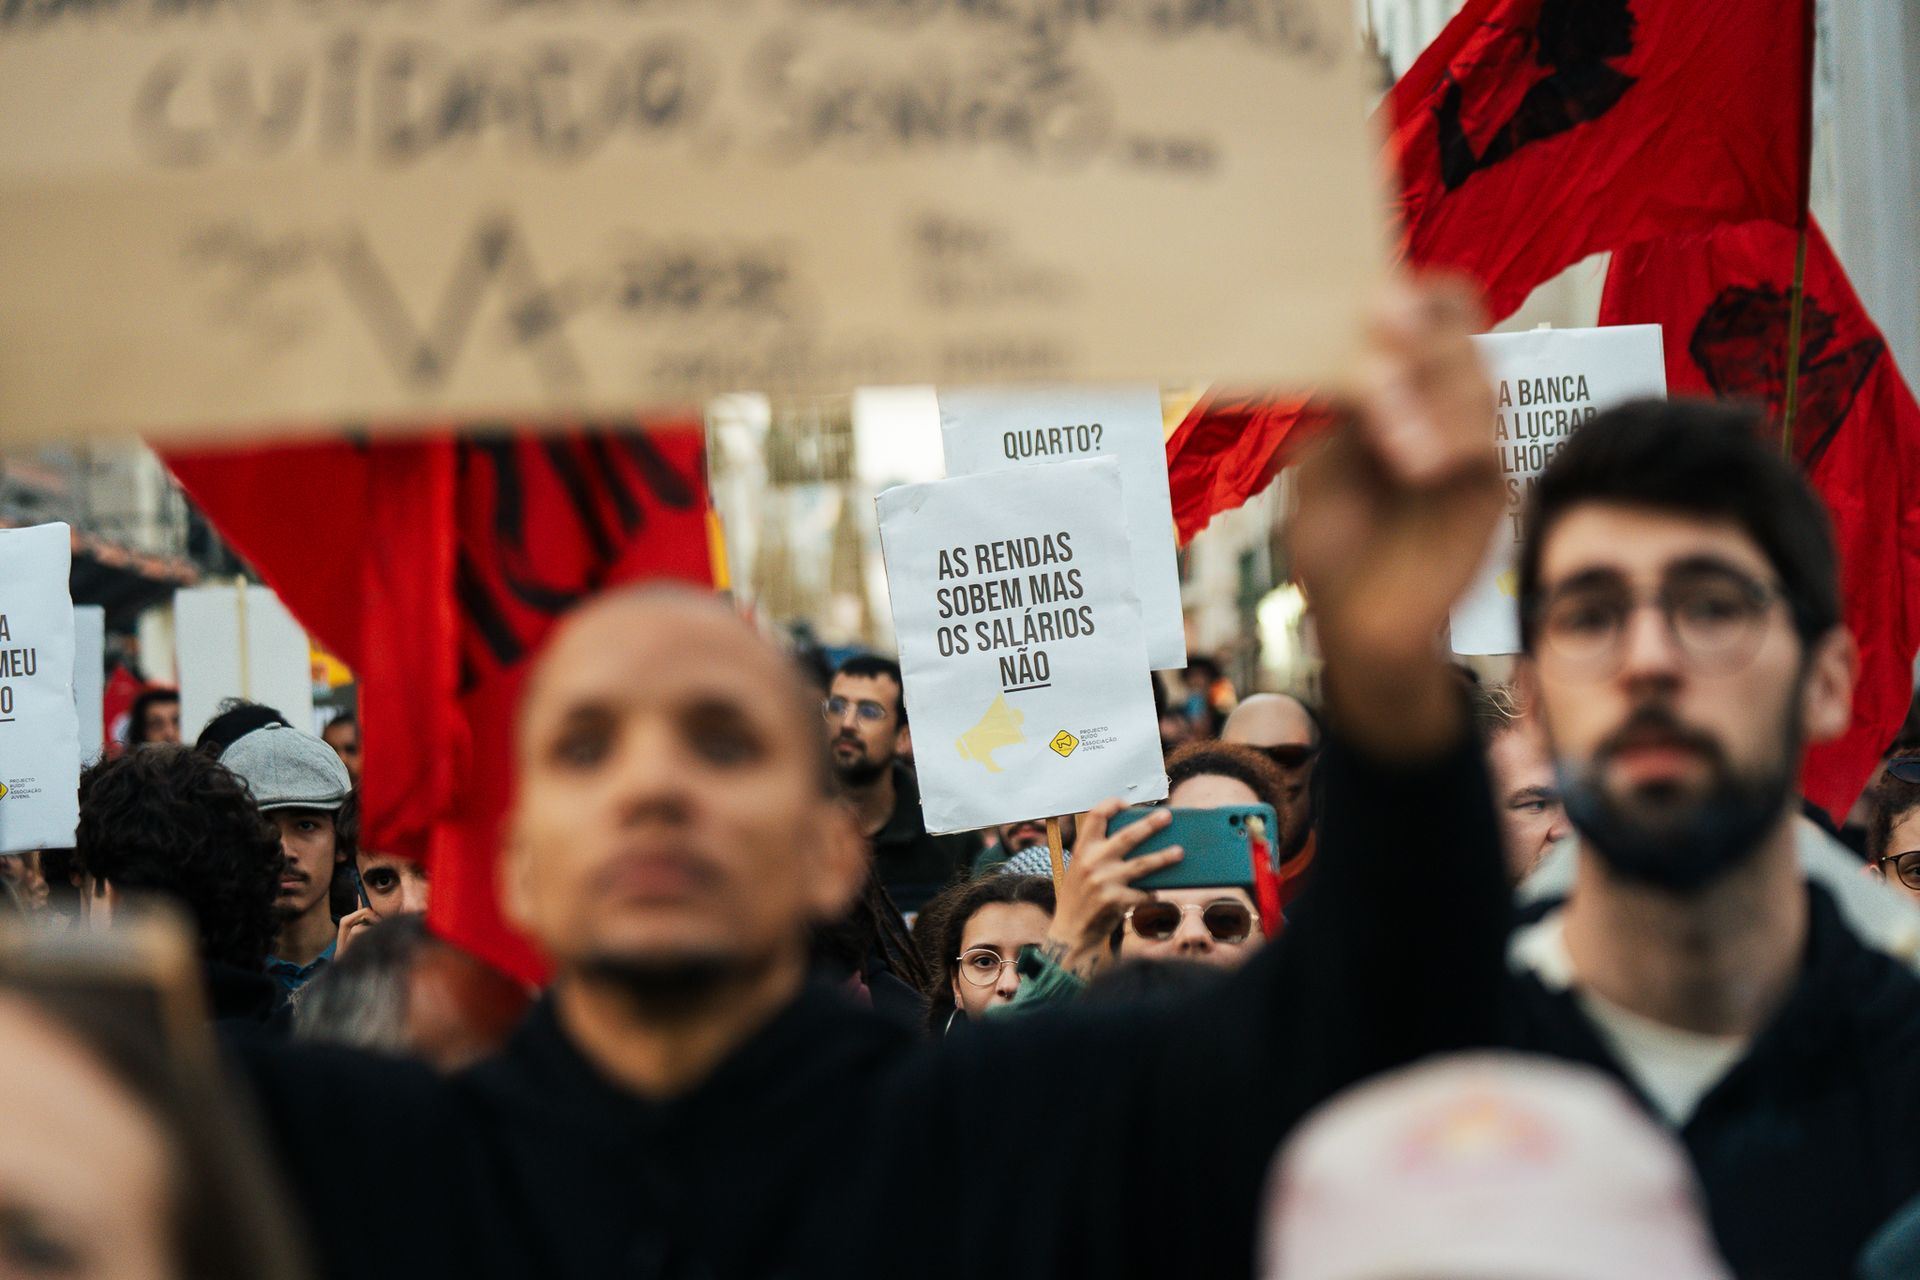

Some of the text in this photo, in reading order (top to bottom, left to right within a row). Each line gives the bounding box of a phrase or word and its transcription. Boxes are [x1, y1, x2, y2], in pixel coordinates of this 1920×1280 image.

[1518, 375, 1591, 407] BANCA
[1003, 423, 1104, 460] QUARTO?
[938, 531, 1073, 580] AS RENDAS
[936, 568, 1084, 619] SOBEM MAS
[937, 605, 1095, 657] OS SALÁRIOS
[999, 647, 1050, 687] NÃO
[1080, 726, 1108, 734] PROJECTO
[1082, 736, 1117, 746] ASSOCIAÇÃO
